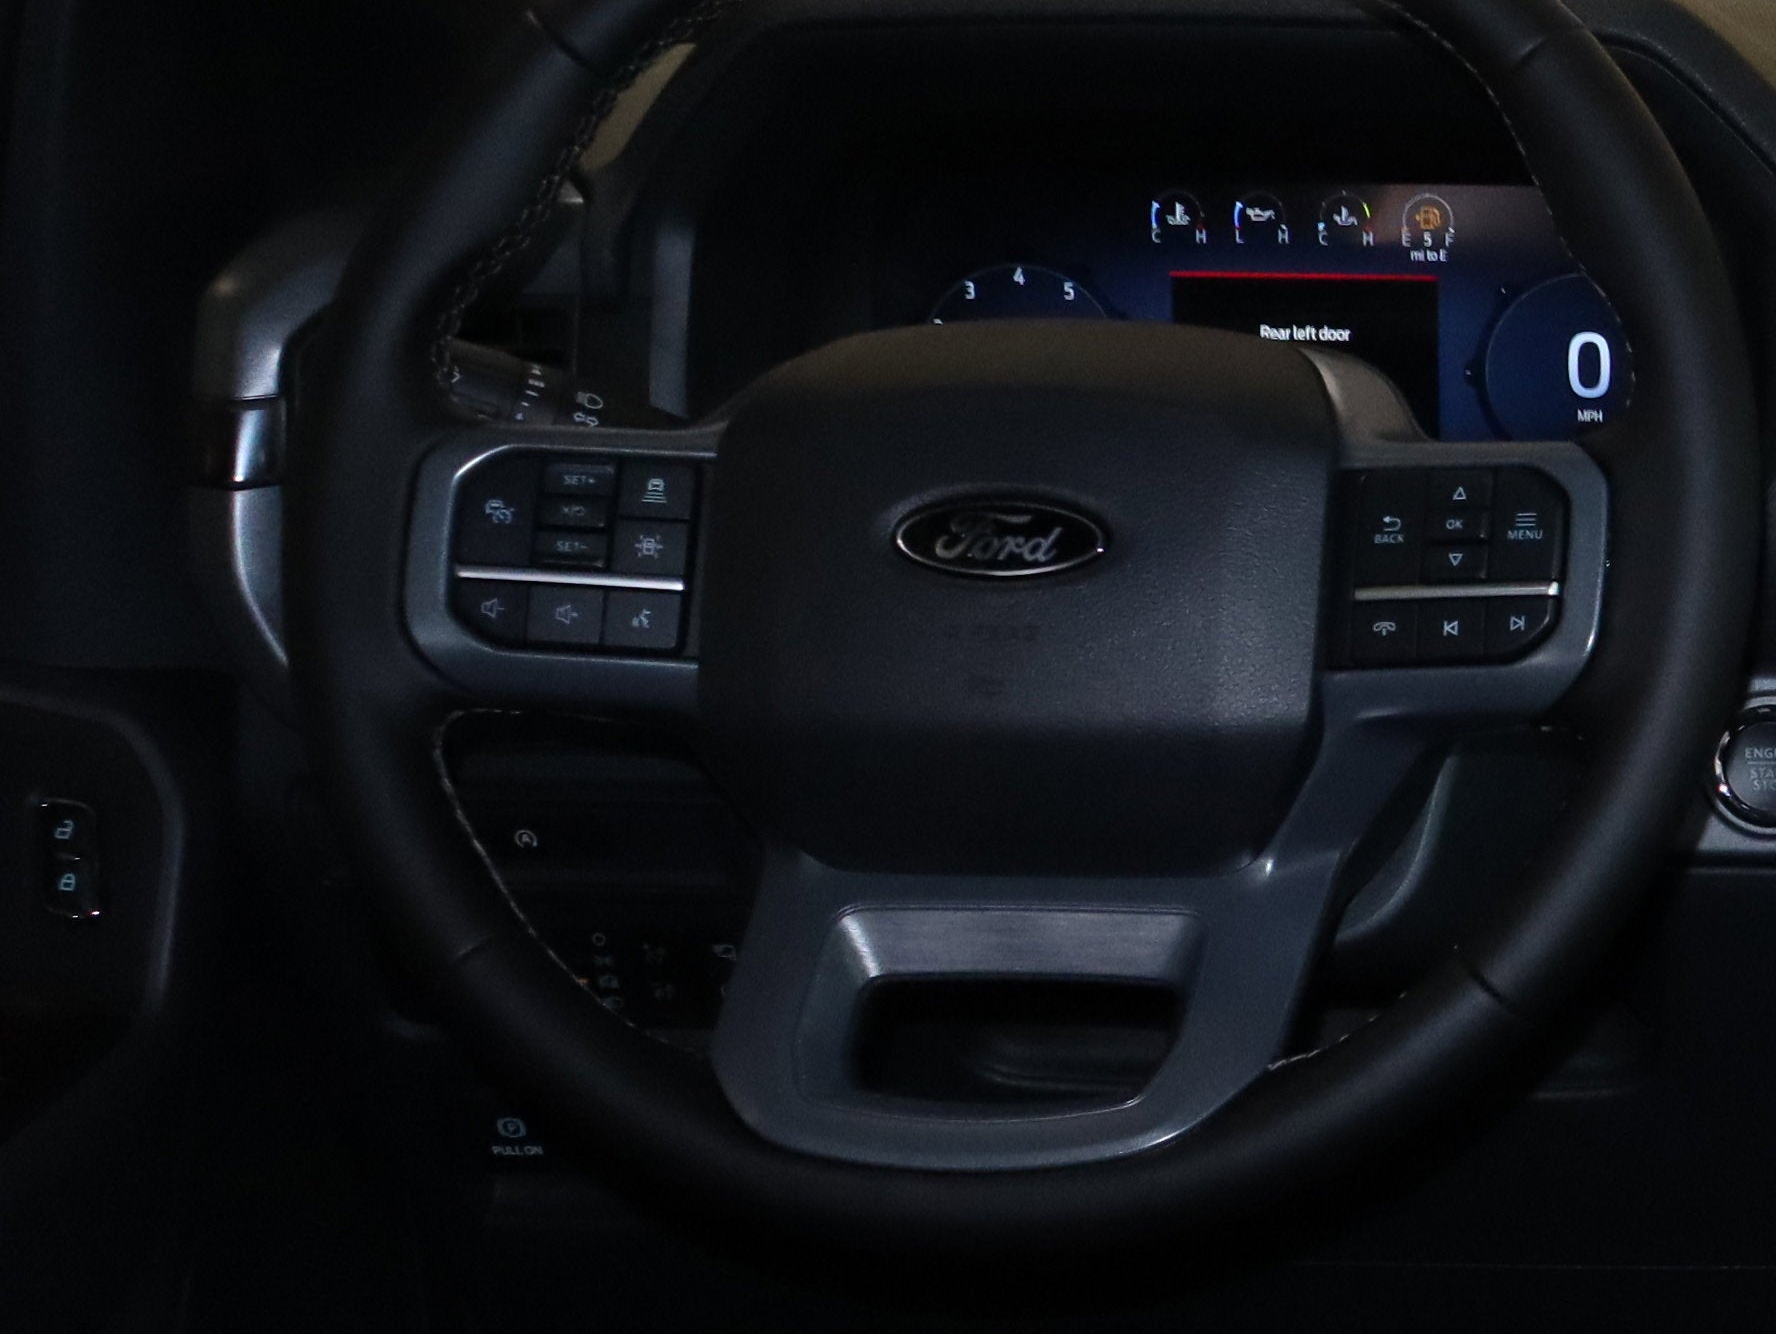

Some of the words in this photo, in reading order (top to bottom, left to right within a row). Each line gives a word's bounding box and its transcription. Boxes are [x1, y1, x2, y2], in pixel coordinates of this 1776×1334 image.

[1152, 230, 1161, 244] C
[1196, 229, 1207, 244] H
[1235, 229, 1244, 244] L
[1278, 229, 1289, 245] H
[1319, 231, 1328, 246] C
[1362, 230, 1374, 246] H
[1402, 231, 1411, 247] E
[1423, 232, 1432, 247] 5
[1445, 232, 1454, 247] F
[1012, 267, 1025, 285] 4
[964, 280, 976, 300] 3
[1063, 281, 1075, 301] 5
[1260, 324, 1290, 340] Rear
[1292, 324, 1317, 341] left
[1319, 326, 1351, 342] door
[1567, 331, 1611, 399] 0
[1577, 409, 1603, 423] MPH
[1445, 519, 1464, 530] OK
[934, 510, 1064, 563] Ford
[1373, 534, 1405, 544] BACK
[1507, 530, 1544, 540] MENU
